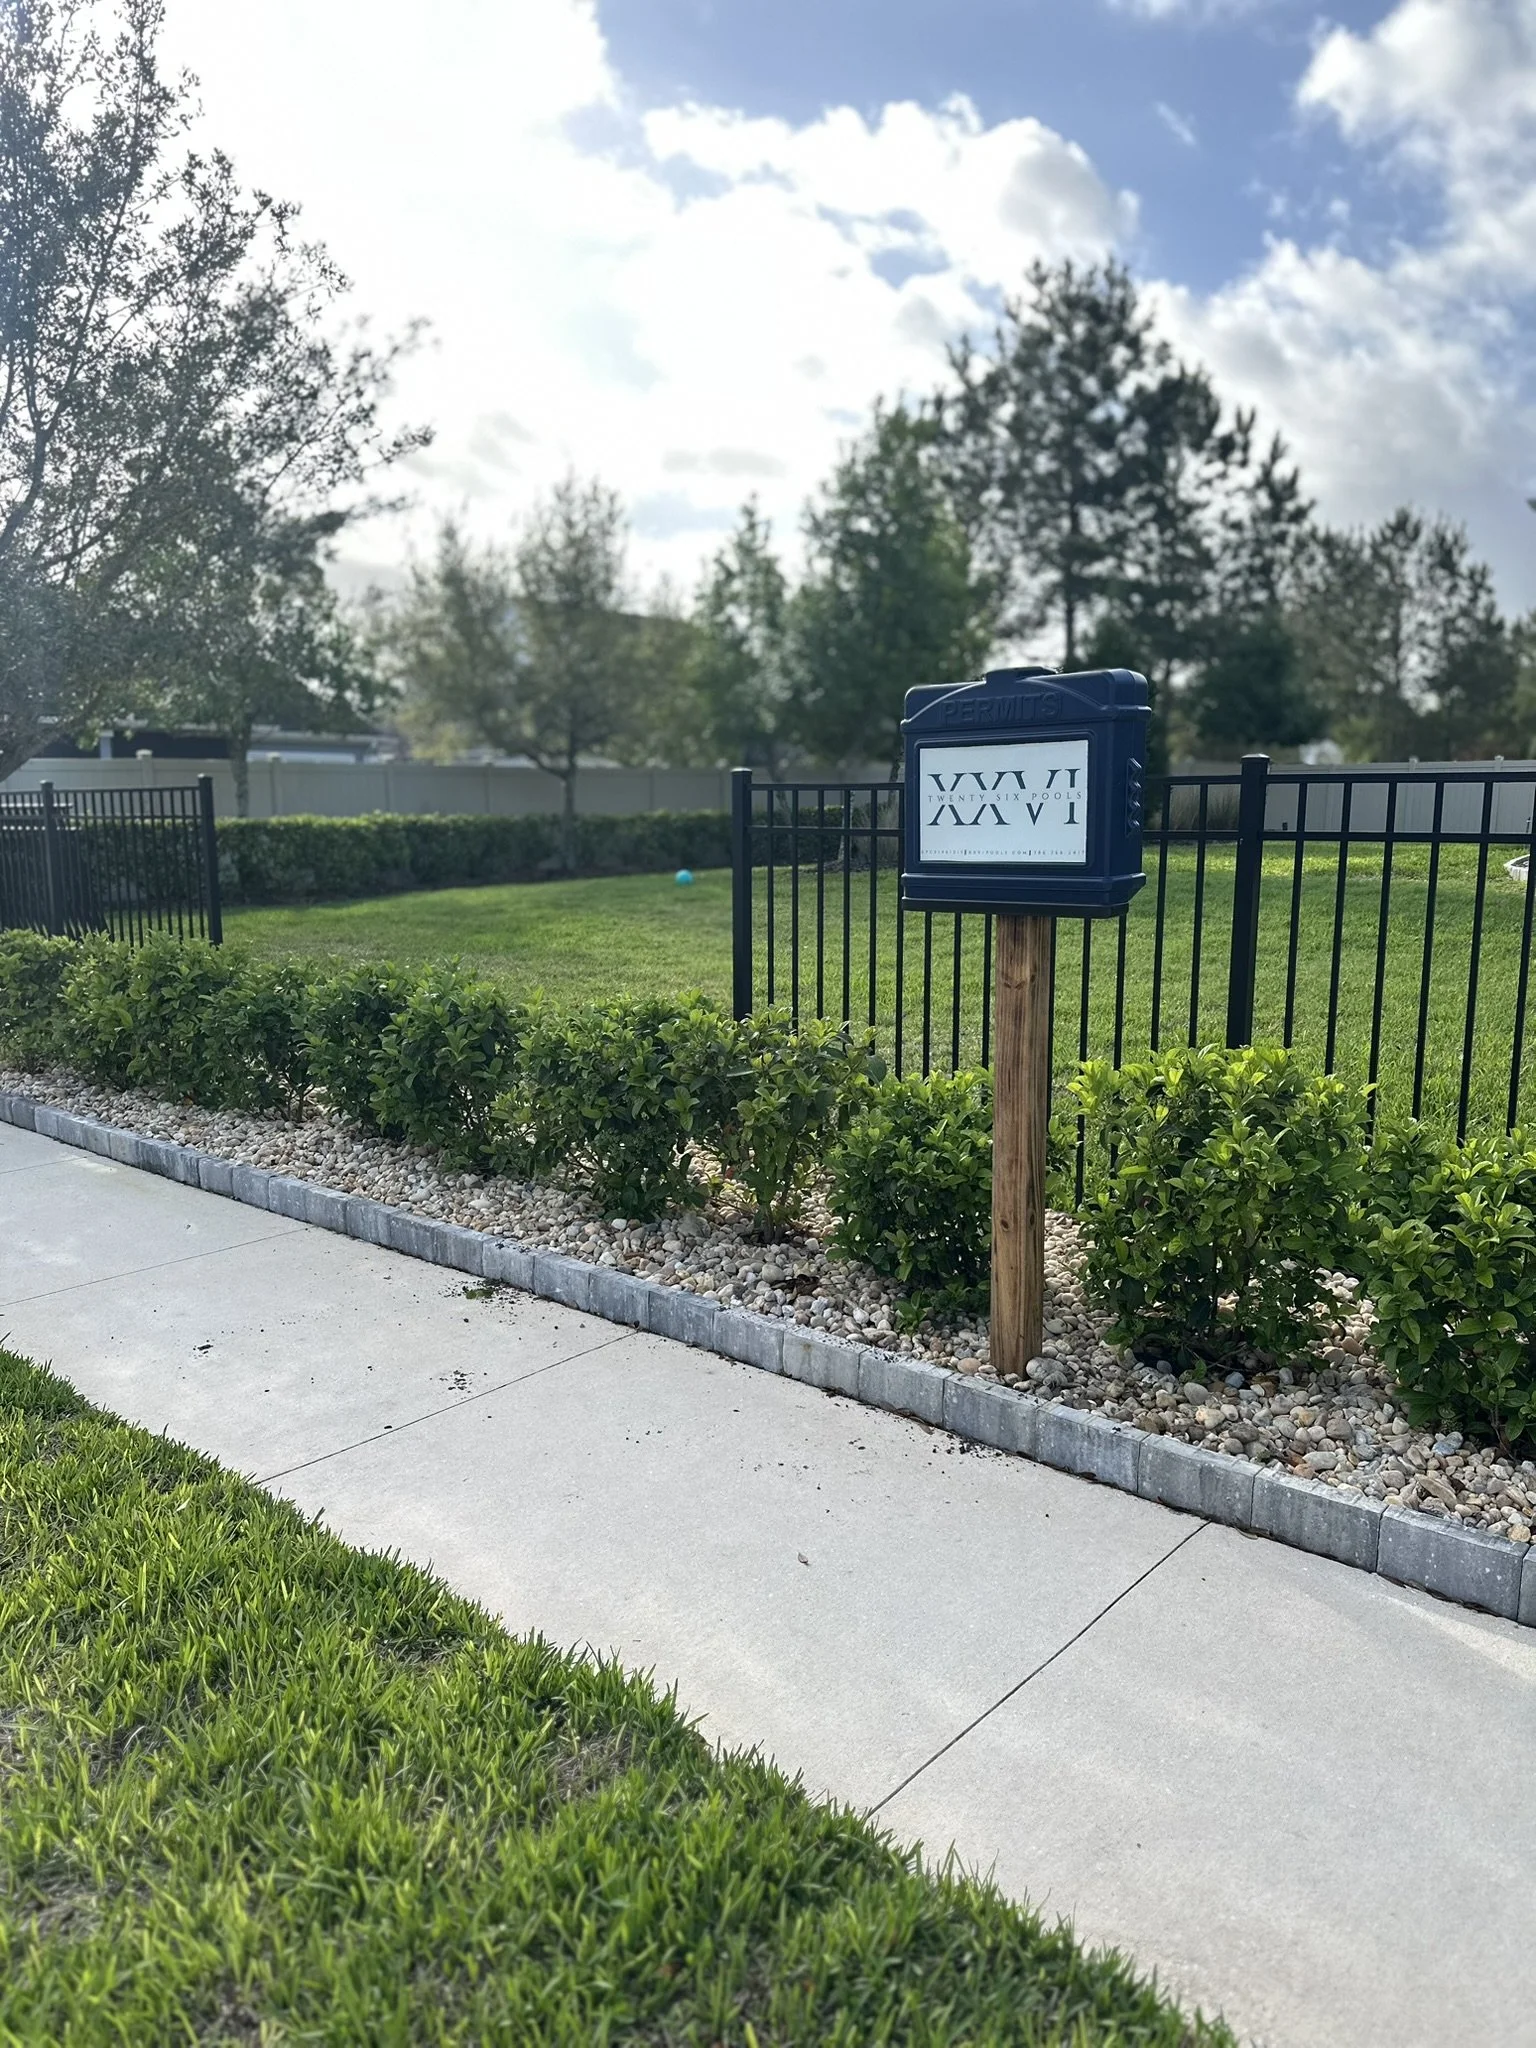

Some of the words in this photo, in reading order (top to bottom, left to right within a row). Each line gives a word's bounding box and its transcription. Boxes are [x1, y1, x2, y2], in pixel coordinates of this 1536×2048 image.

[941, 692, 1060, 724] PERMITS
[926, 768, 1081, 826] XXVI
[928, 794, 985, 803] TWENTY
[996, 793, 1020, 801] SIX
[1032, 791, 1082, 800] POOLS
